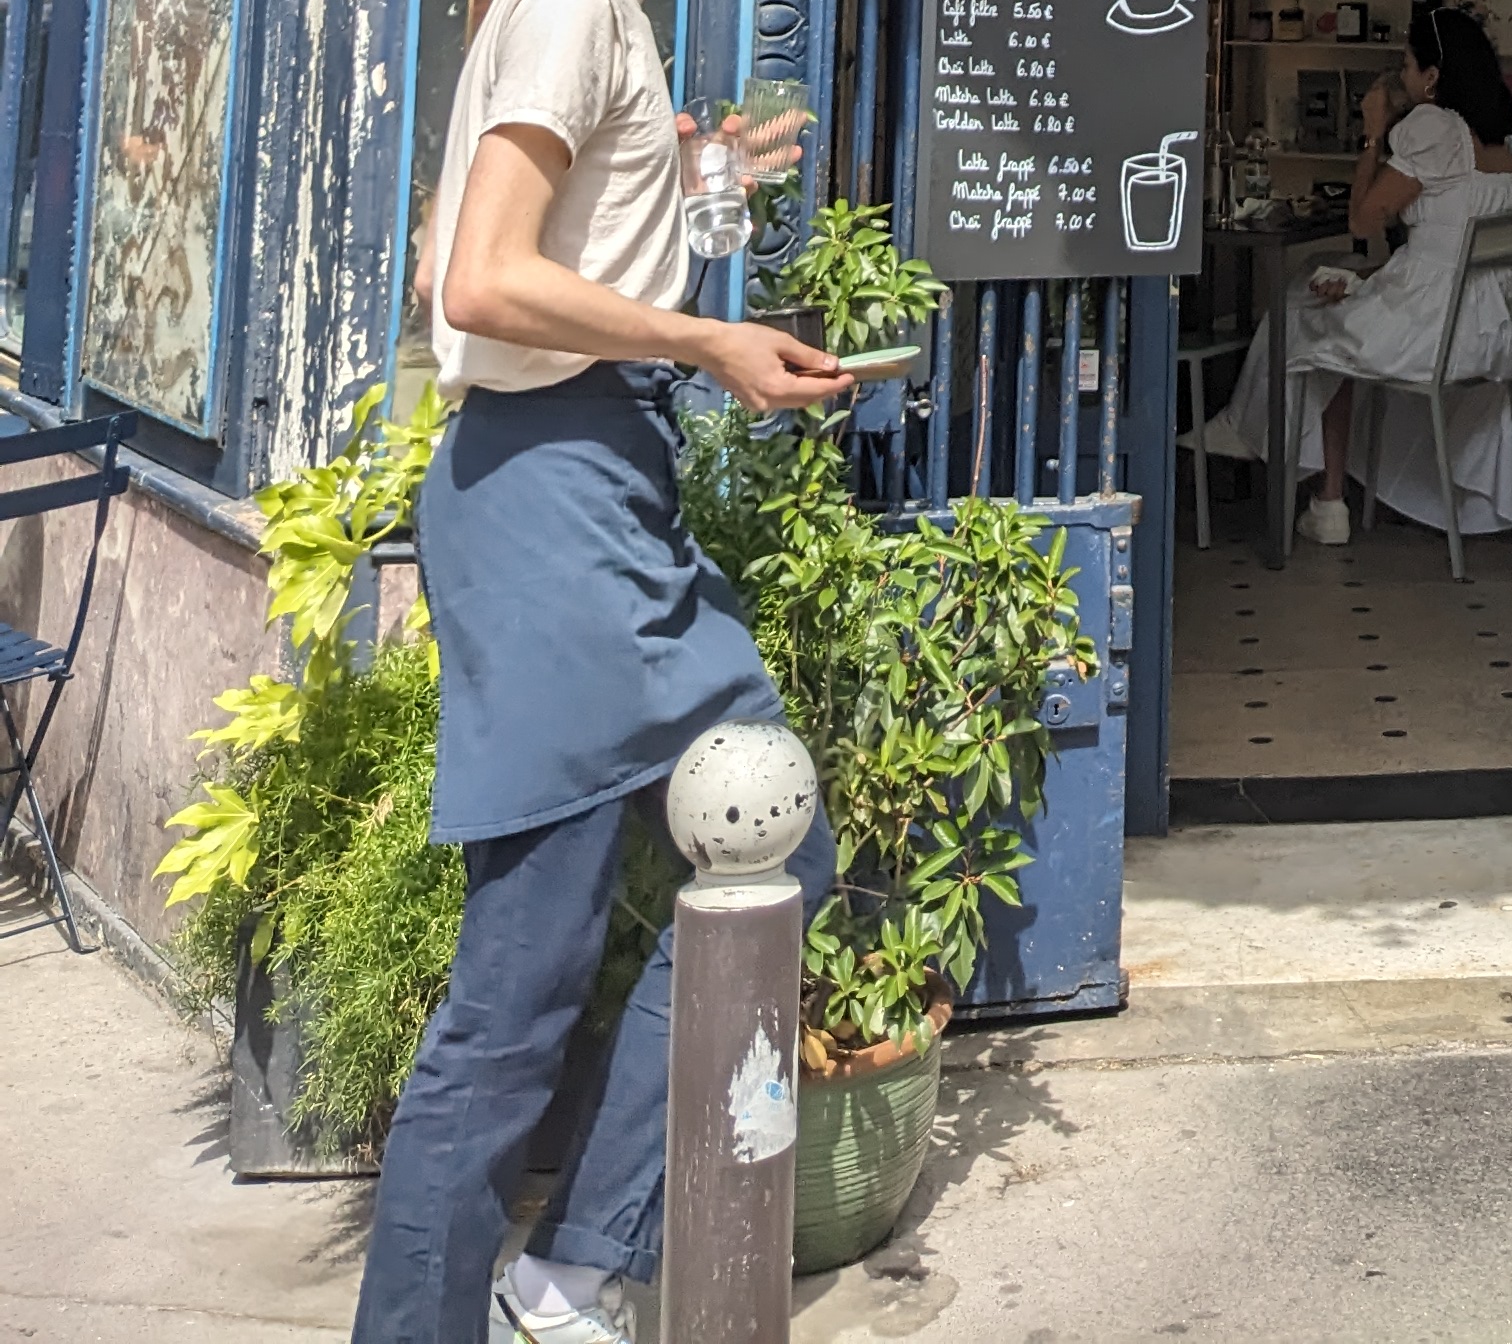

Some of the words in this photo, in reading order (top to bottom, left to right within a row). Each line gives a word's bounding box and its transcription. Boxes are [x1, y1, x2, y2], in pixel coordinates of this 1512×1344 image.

[969, 0, 998, 27] filtre
[941, 29, 972, 45] Latte
[969, 56, 995, 75] Latte
[935, 85, 981, 104] Matcha
[987, 87, 1017, 105] Latte
[937, 109, 984, 130] Golden
[992, 112, 1020, 131] Latte
[958, 149, 990, 171] Latte
[997, 152, 1035, 182] frappé
[952, 181, 1003, 200] Matcha
[1006, 182, 1041, 212] frappé
[991, 209, 1033, 241] frappé
